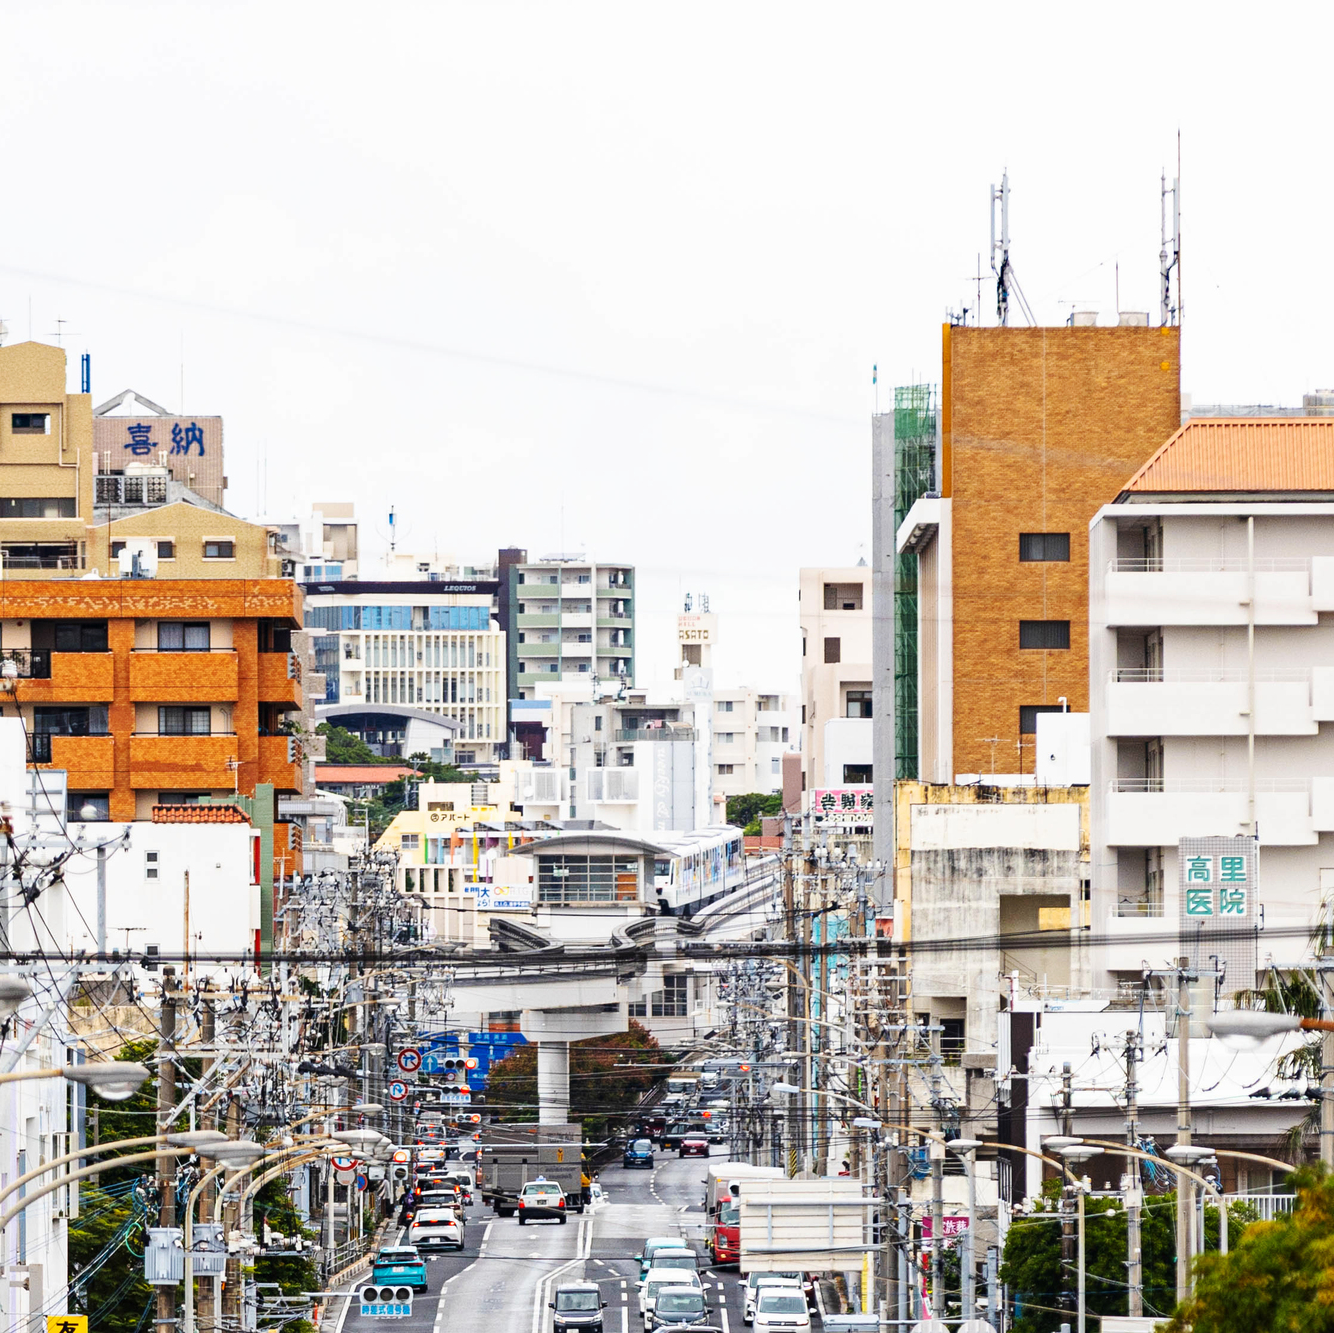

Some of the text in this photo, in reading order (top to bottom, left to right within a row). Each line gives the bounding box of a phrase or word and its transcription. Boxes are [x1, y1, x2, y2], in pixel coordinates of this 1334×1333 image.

[124, 422, 205, 456] 喜納
[679, 629, 709, 640] ASATO
[1186, 855, 1247, 882] 高里
[1186, 889, 1246, 915] 医院
[943, 1221, 967, 1234] 族葬
